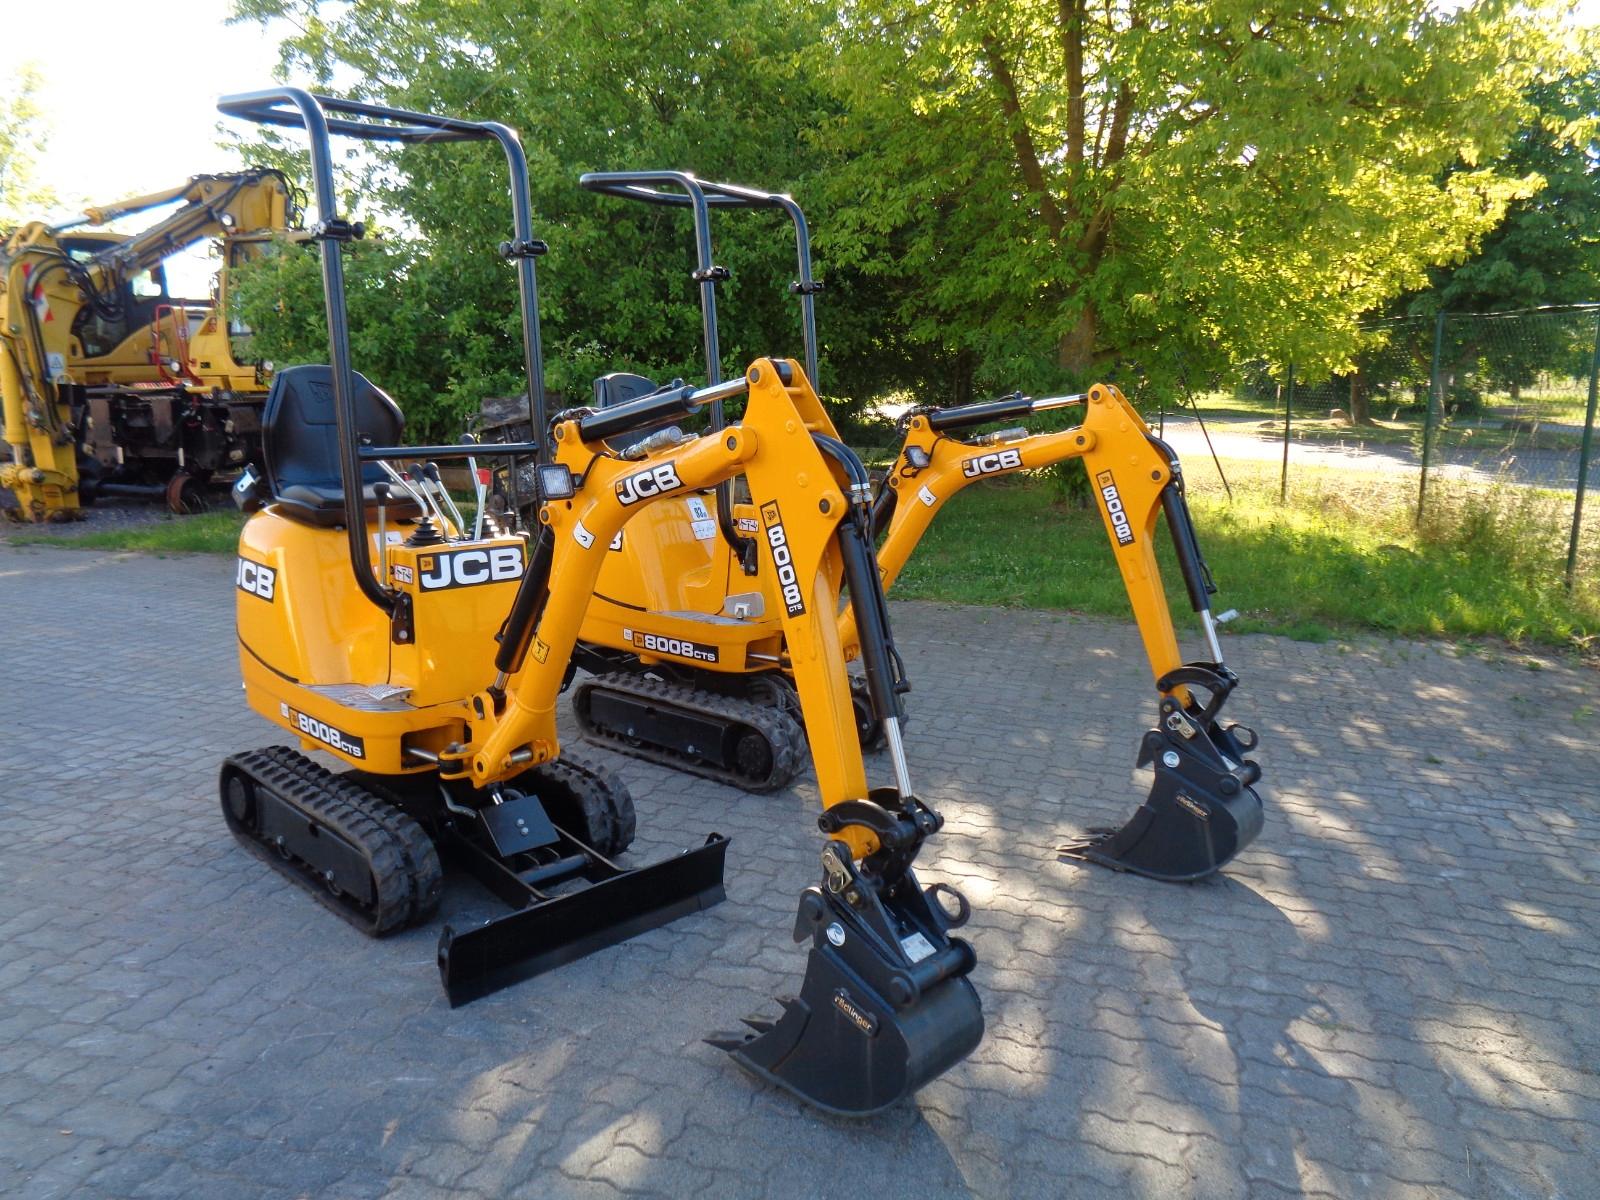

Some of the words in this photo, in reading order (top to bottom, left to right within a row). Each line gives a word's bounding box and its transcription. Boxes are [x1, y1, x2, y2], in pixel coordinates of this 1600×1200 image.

[618, 464, 681, 504] JCB
[962, 450, 1021, 477] JCB
[1103, 486, 1131, 539] 8008
[236, 558, 275, 600] JCB
[421, 547, 524, 589] JCB
[768, 525, 800, 605] 8008
